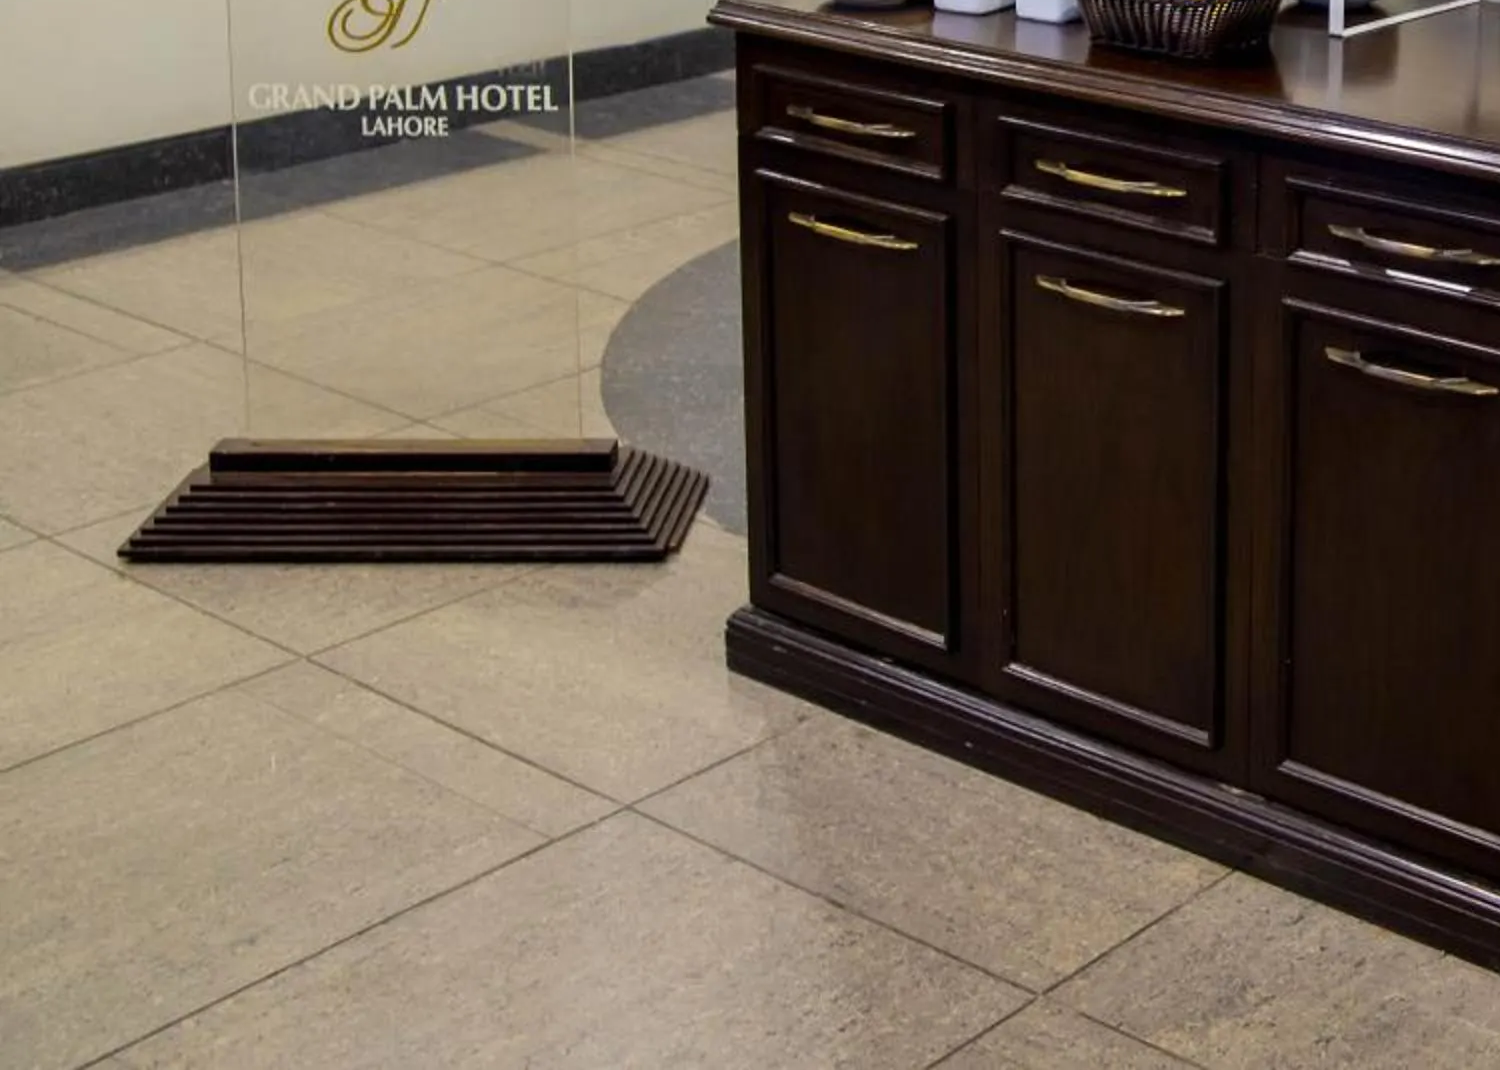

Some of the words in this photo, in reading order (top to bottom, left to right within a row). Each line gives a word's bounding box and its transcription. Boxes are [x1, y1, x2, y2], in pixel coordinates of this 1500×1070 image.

[249, 83, 361, 111] GRAND
[368, 85, 448, 111] PALM
[456, 84, 559, 111] HOTEL
[361, 116, 449, 137] LAHORE
